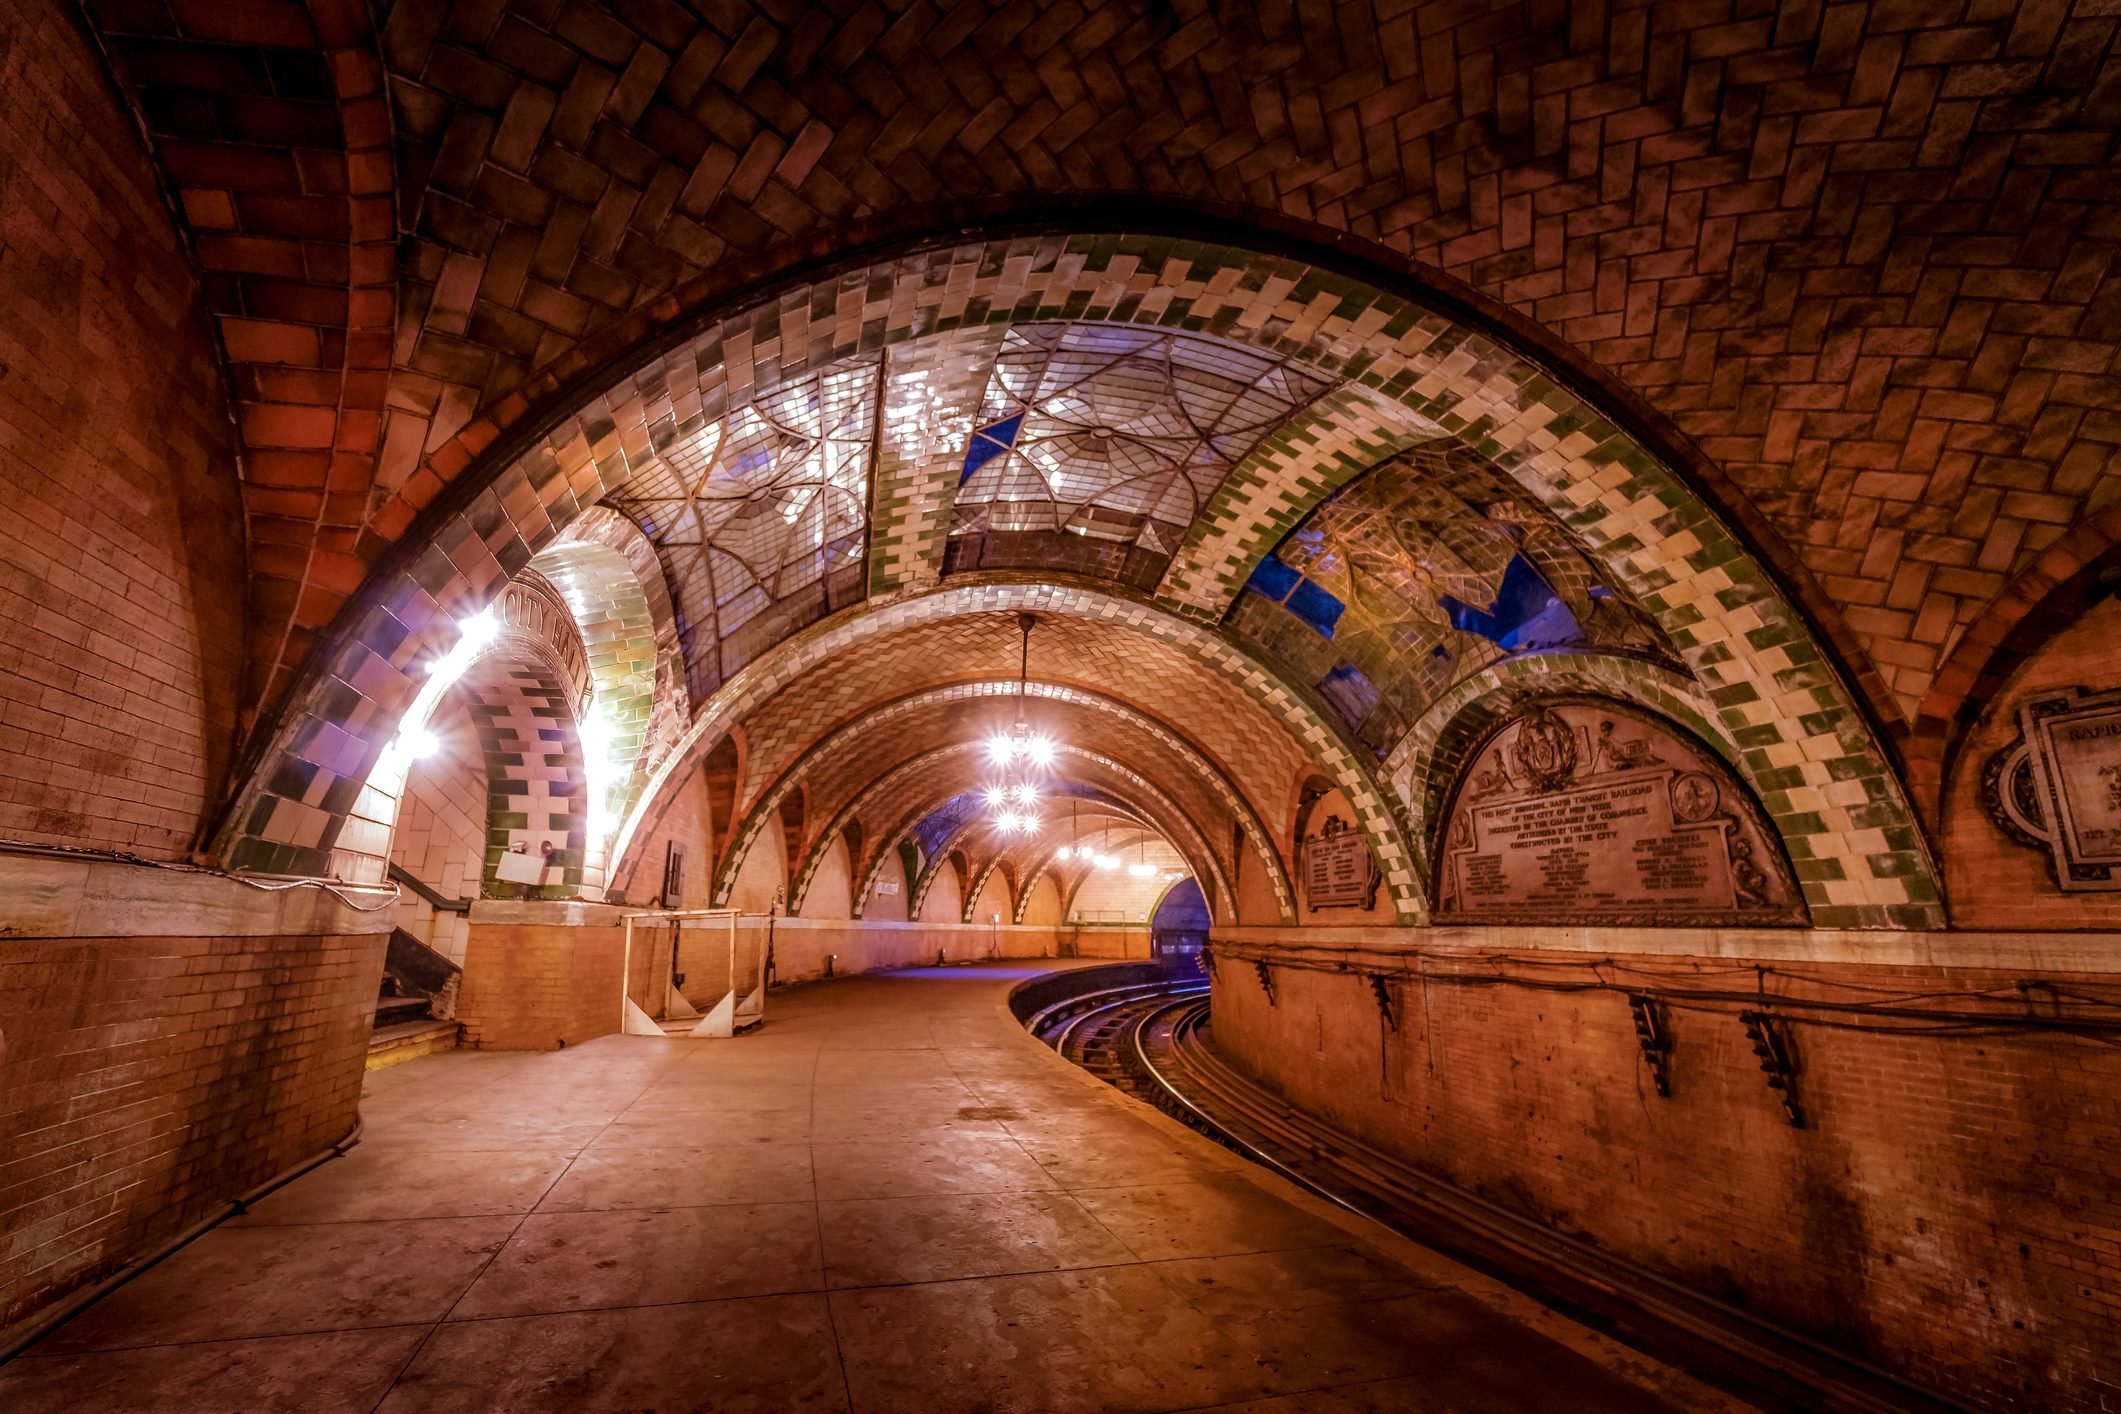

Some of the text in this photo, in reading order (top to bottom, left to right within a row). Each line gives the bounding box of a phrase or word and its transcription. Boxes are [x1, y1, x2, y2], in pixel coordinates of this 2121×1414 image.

[503, 589, 581, 697] CITY HALL
[1574, 793, 1607, 805] TRANSIT
[1610, 785, 1653, 799] RAILROAD
[1537, 810, 1554, 819] CITY
[1599, 806, 1649, 821] COMMERCE
[1597, 830, 1618, 840] CITY
